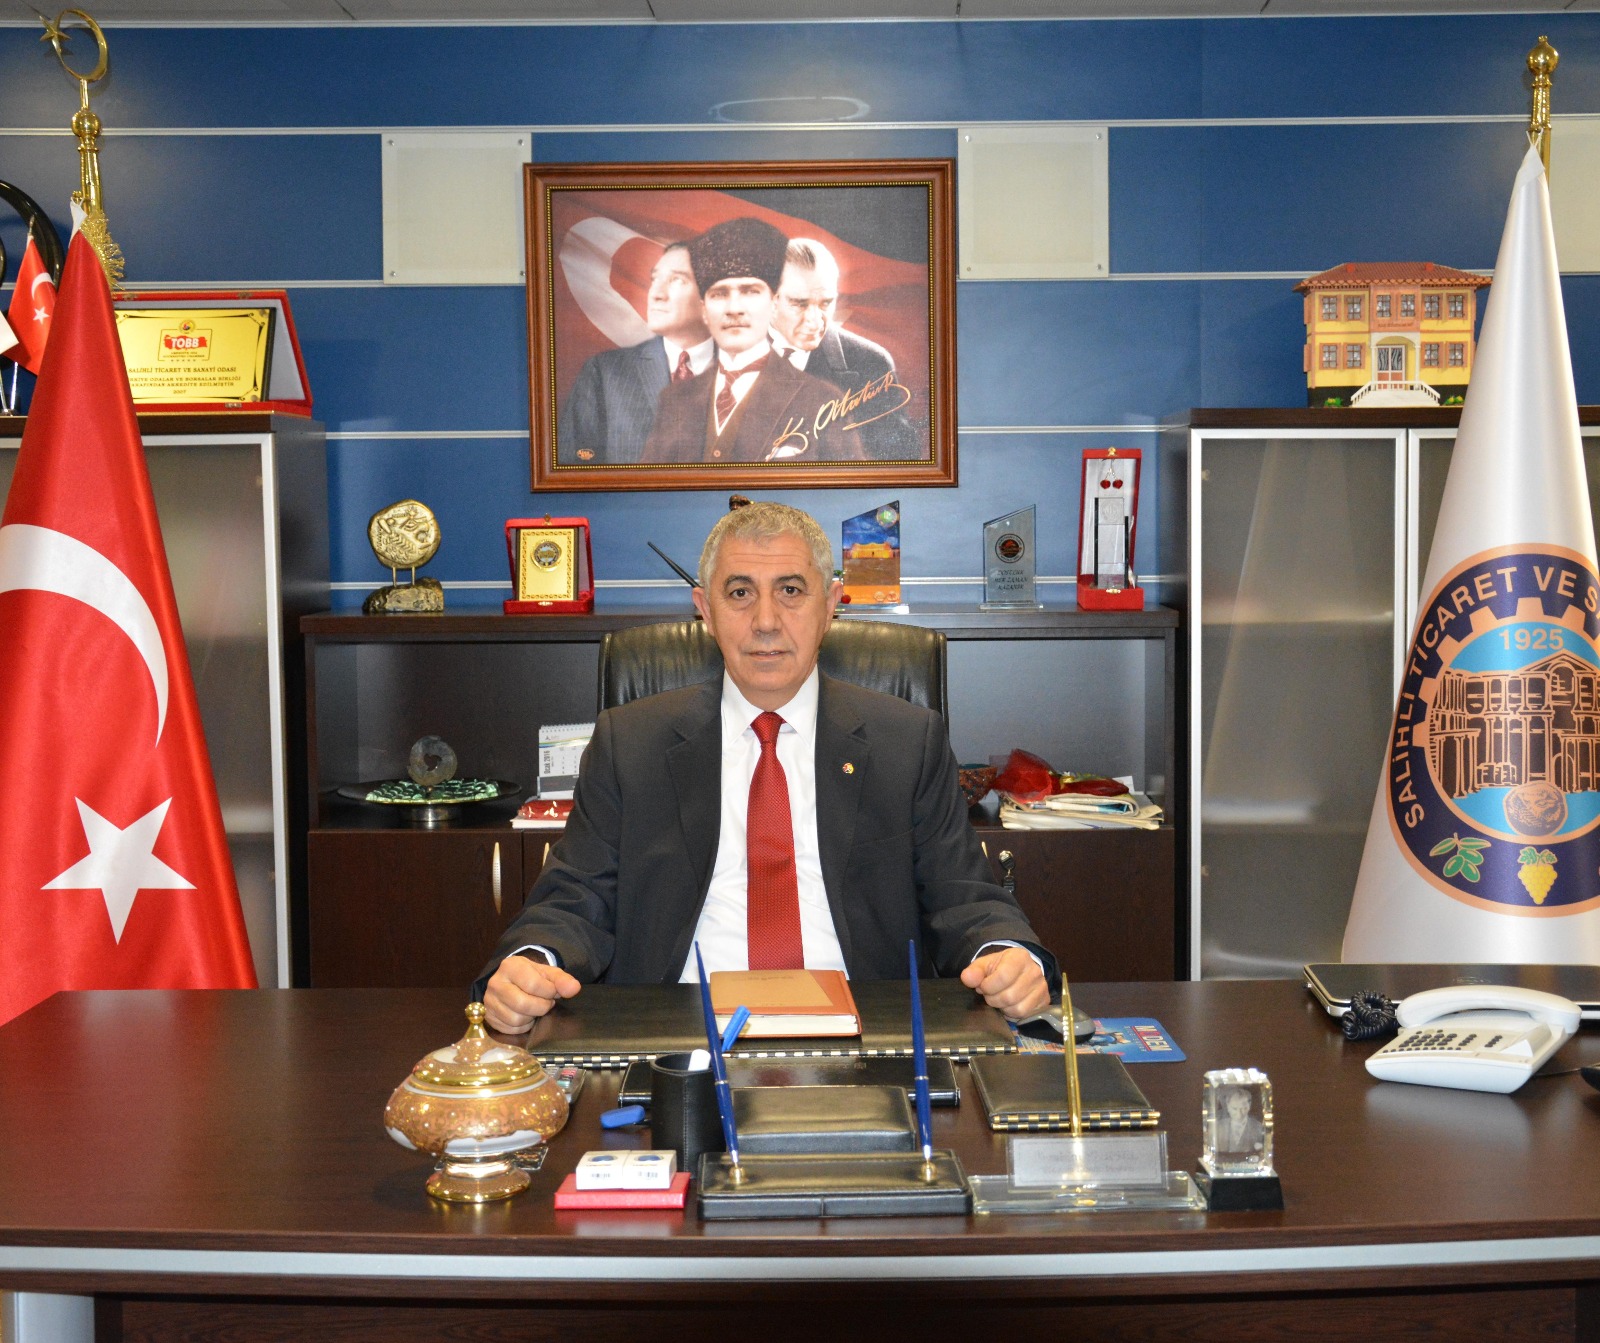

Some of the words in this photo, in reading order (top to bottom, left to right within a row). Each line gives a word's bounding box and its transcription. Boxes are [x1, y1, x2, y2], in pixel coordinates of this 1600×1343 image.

[171, 337, 199, 349] TOBB
[1499, 628, 1565, 651] 1925
[1392, 692, 1425, 829] SALİHLİ
[1409, 566, 1518, 677] TİCARET
[1532, 565, 1577, 598] VE
[1584, 585, 1600, 621] S
